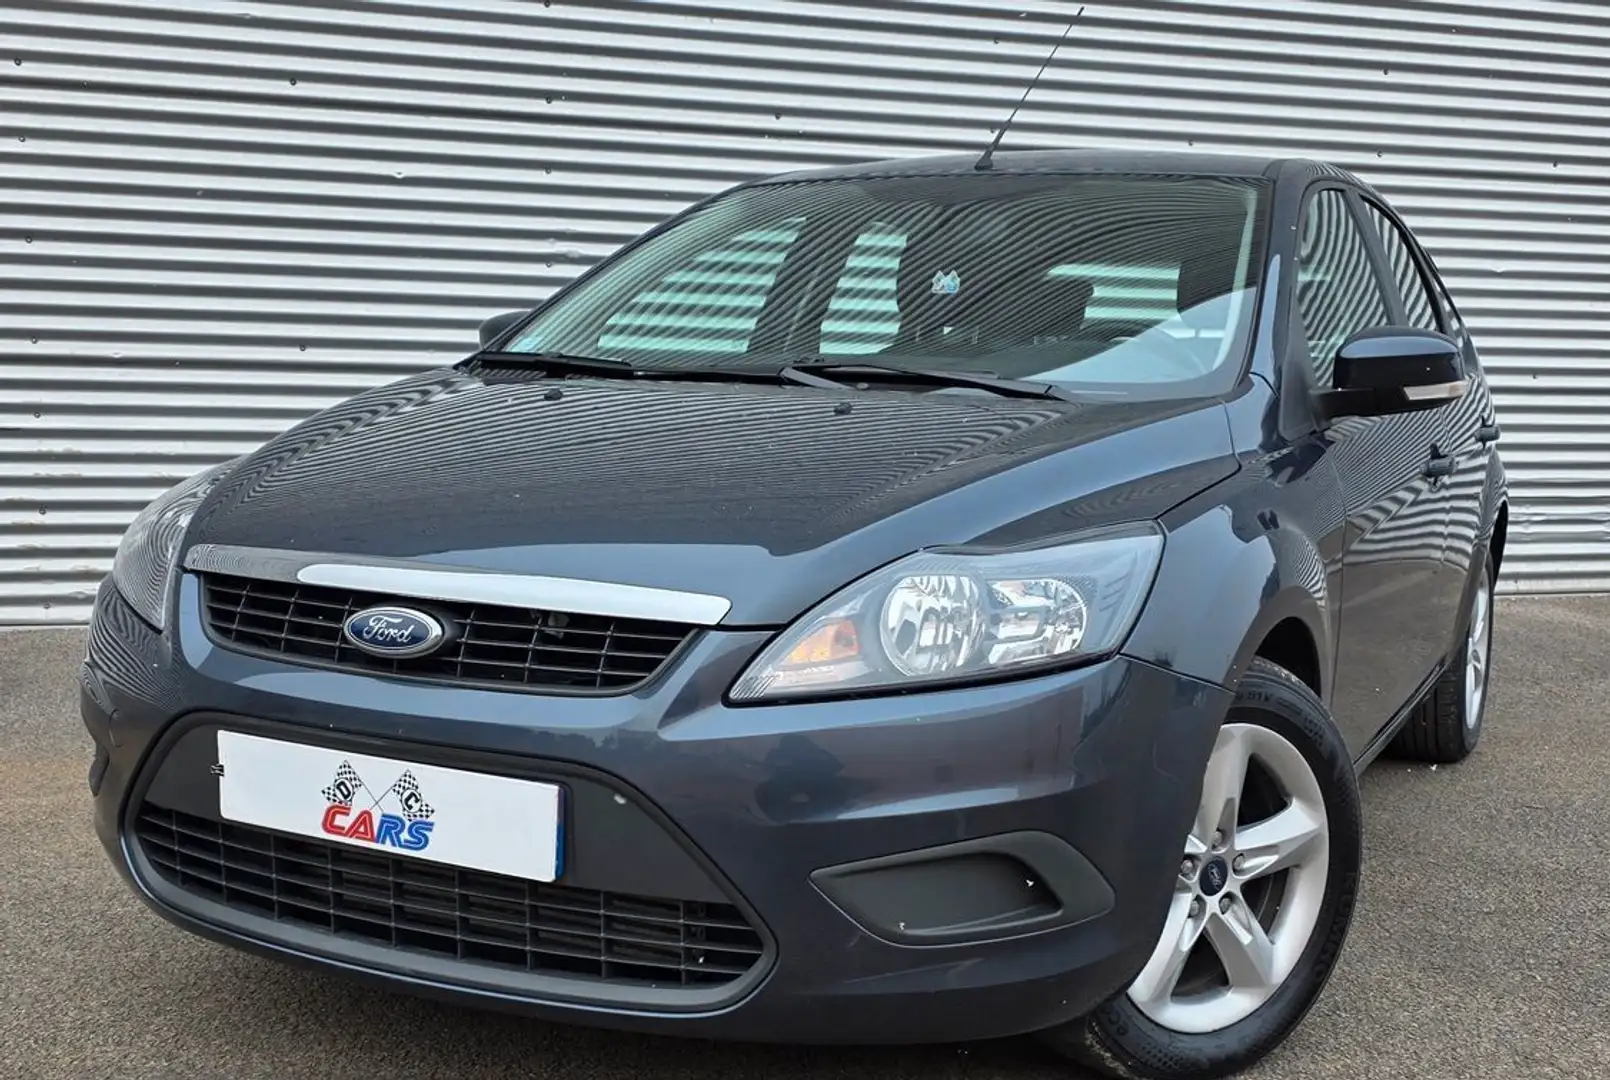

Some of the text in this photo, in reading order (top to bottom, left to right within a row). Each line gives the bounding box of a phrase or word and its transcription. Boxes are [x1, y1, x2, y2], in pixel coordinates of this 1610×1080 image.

[362, 615, 415, 643] Ford
[336, 779, 421, 814] D C
[321, 803, 435, 851] CARS
